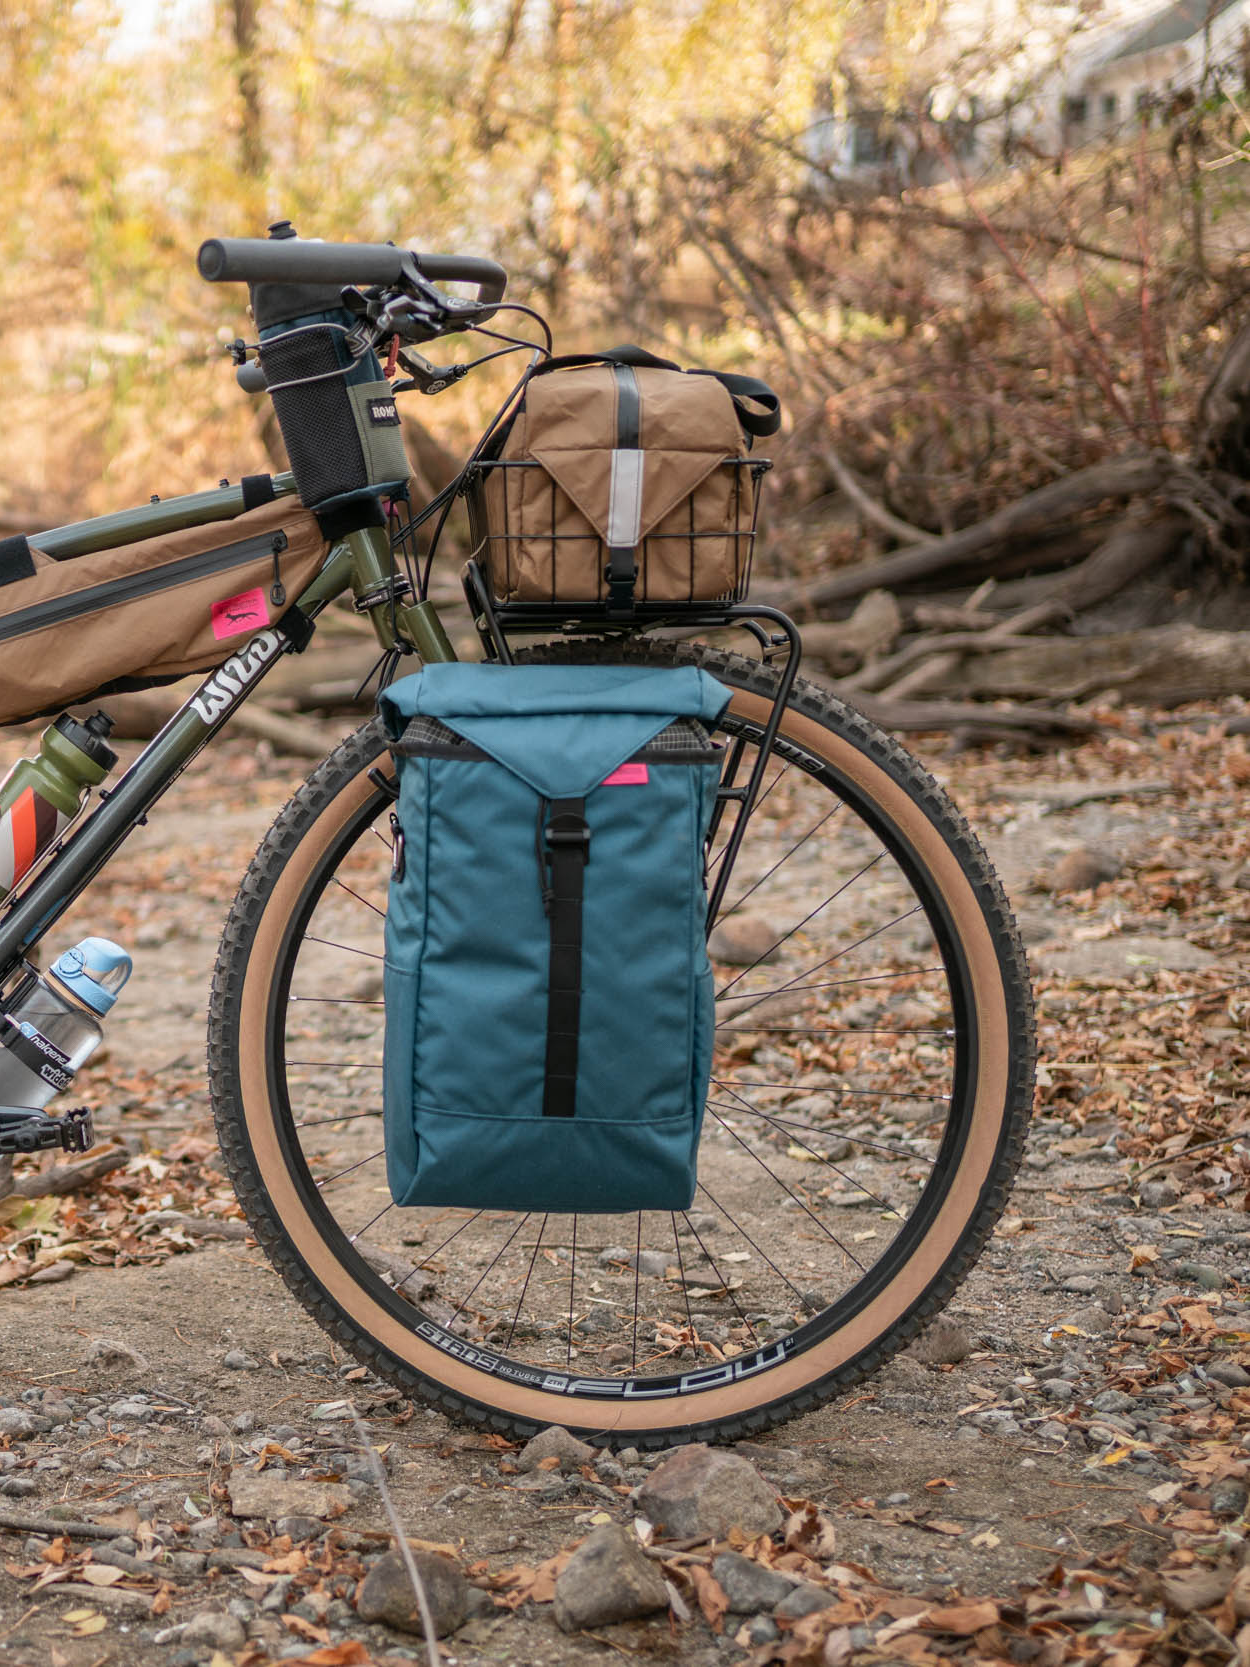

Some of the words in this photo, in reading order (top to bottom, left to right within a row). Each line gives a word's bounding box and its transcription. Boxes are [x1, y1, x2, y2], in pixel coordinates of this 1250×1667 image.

[371, 405, 396, 418] ROMP
[737, 724, 825, 772] STAS
[30, 1035, 68, 1066] nalgene
[415, 1321, 500, 1372] STANS
[499, 1364, 513, 1375] NO
[513, 1369, 543, 1383] TUBES
[566, 1342, 786, 1398] FLOW
[784, 1337, 795, 1347] S1
